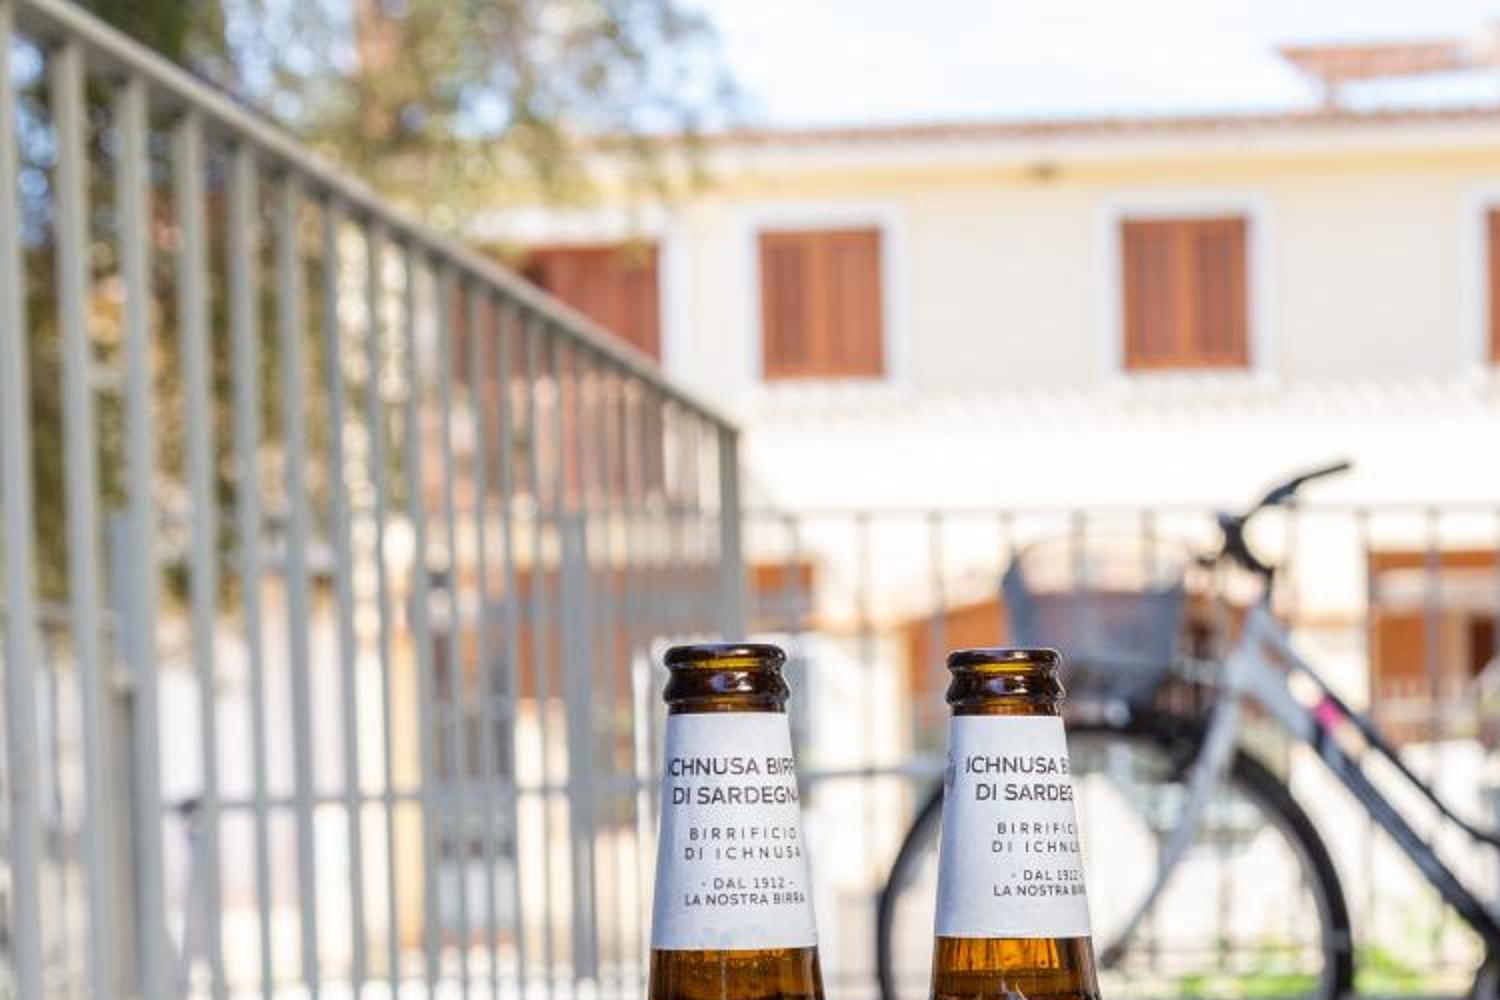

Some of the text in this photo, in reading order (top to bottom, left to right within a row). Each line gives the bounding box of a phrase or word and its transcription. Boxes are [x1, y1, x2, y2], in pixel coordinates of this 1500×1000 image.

[966, 756, 1058, 774] ICHNUSA
[673, 787, 691, 805] DI
[976, 783, 997, 801] DI
[689, 827, 797, 841] BIRRIFICIO
[684, 847, 703, 860] DI
[992, 841, 1012, 853] DI
[1023, 869, 1052, 881] DAL
[713, 877, 747, 890] DAL
[753, 876, 785, 889] 1912
[993, 884, 1012, 896] LA
[685, 893, 700, 906] LA
[705, 892, 769, 905] NOSTRA
